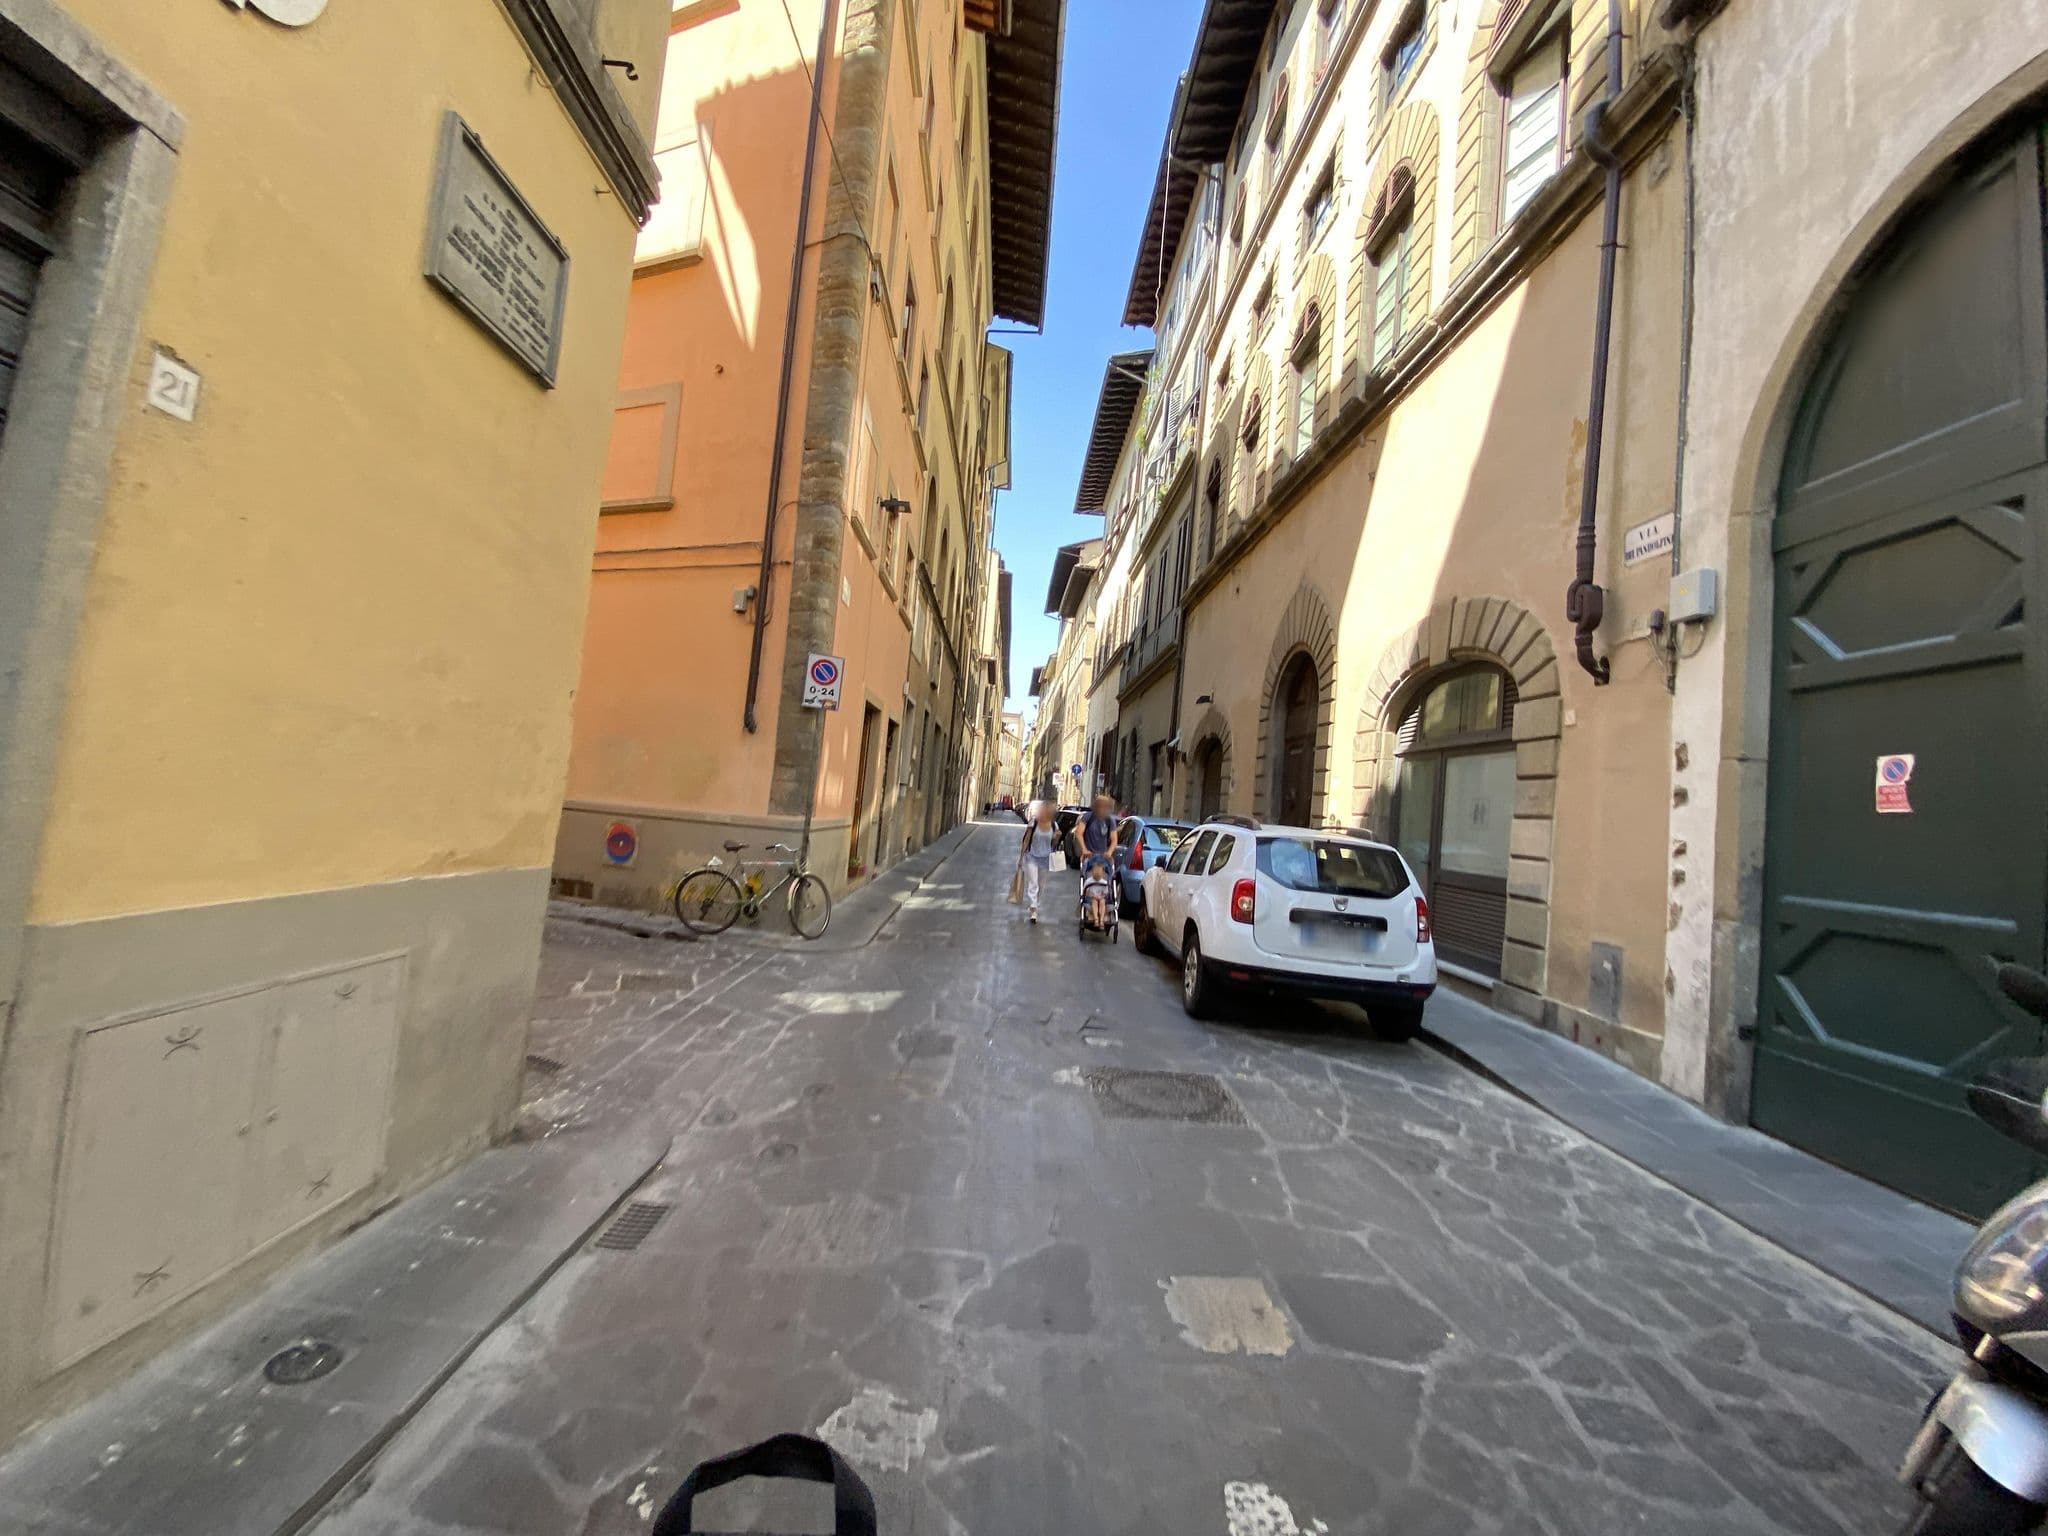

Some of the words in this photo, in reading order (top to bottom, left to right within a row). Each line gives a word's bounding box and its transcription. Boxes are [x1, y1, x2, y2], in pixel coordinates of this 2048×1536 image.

[158, 370, 191, 408] 21
[1639, 525, 1658, 540] VIA
[1636, 535, 1673, 557] PANDOLFIN
[809, 686, 835, 696] 0-24
